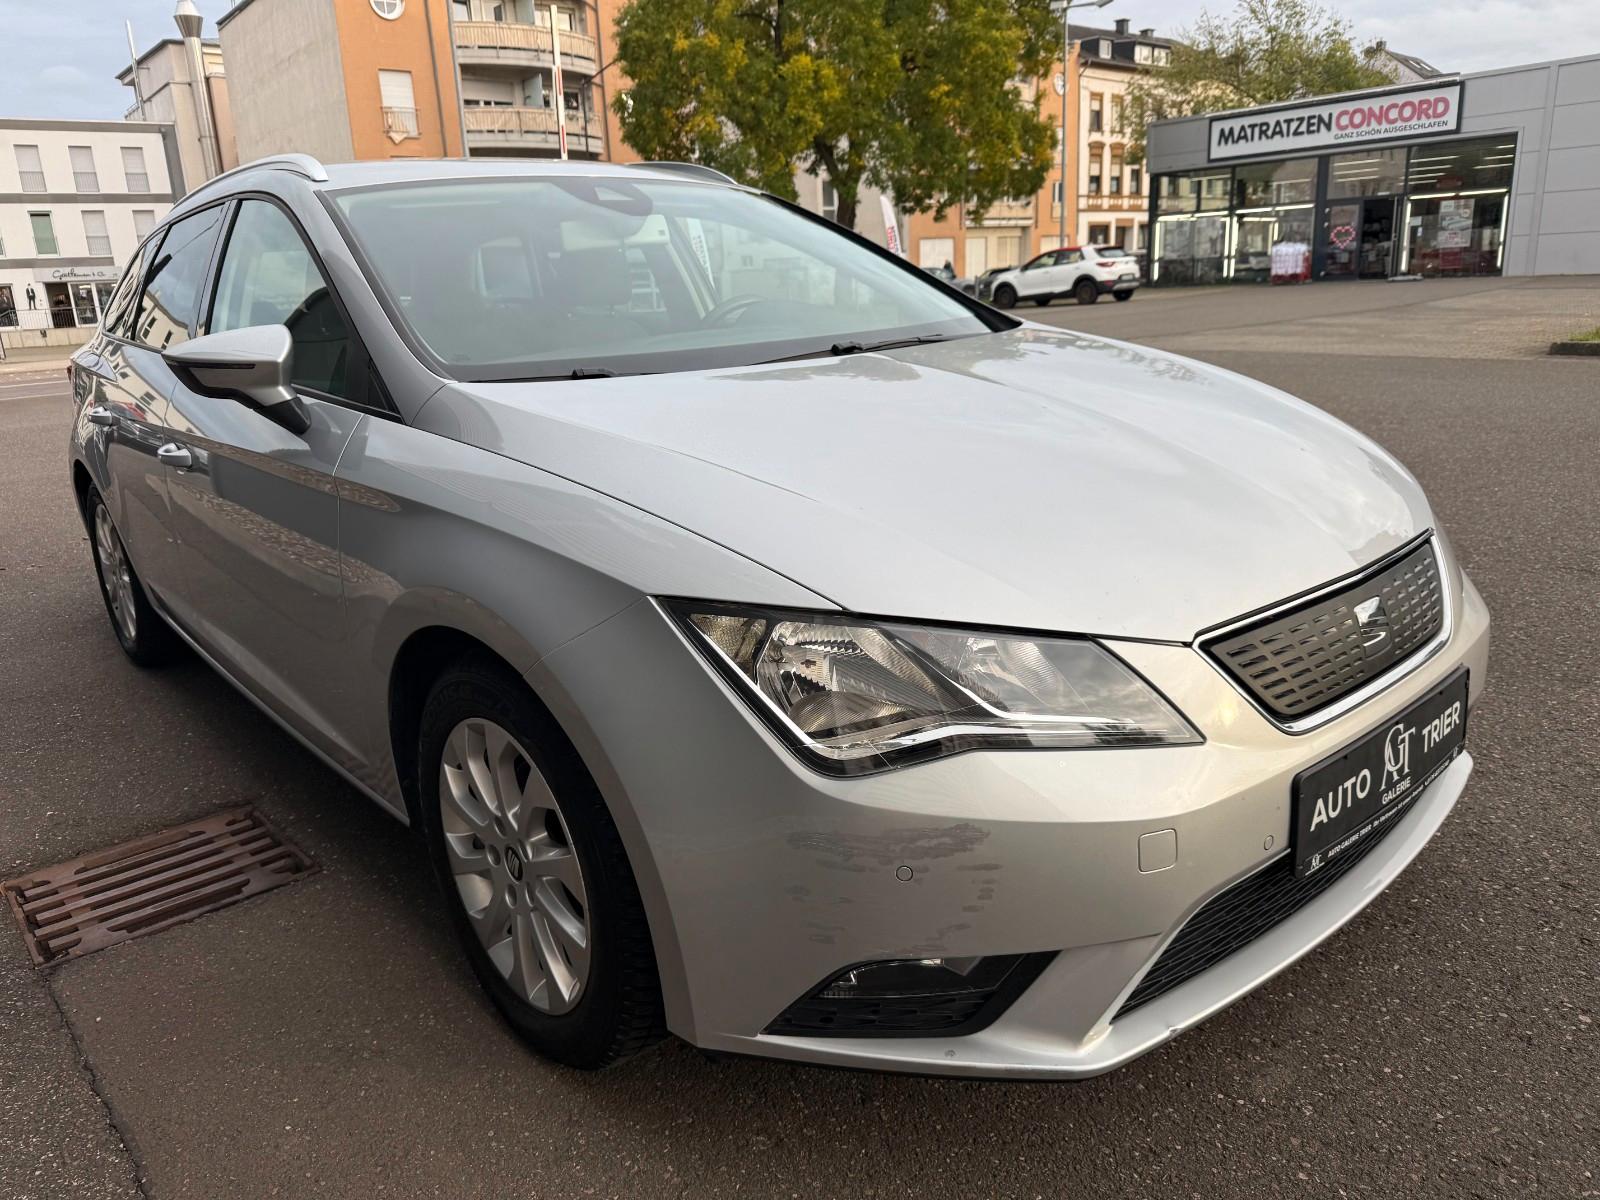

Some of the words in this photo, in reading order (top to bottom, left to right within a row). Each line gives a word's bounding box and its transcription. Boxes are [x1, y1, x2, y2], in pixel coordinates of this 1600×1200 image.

[1217, 112, 1333, 146] MATRATZEN
[1335, 97, 1450, 131] CONCORD
[1334, 130, 1354, 140] GANZ
[1355, 127, 1382, 138] SCHÖN
[1383, 120, 1448, 135] AUSGESCHLAFEN
[1309, 768, 1370, 832] AUTO
[1422, 700, 1460, 753] TRIER
[1381, 776, 1411, 805] GALERIE
